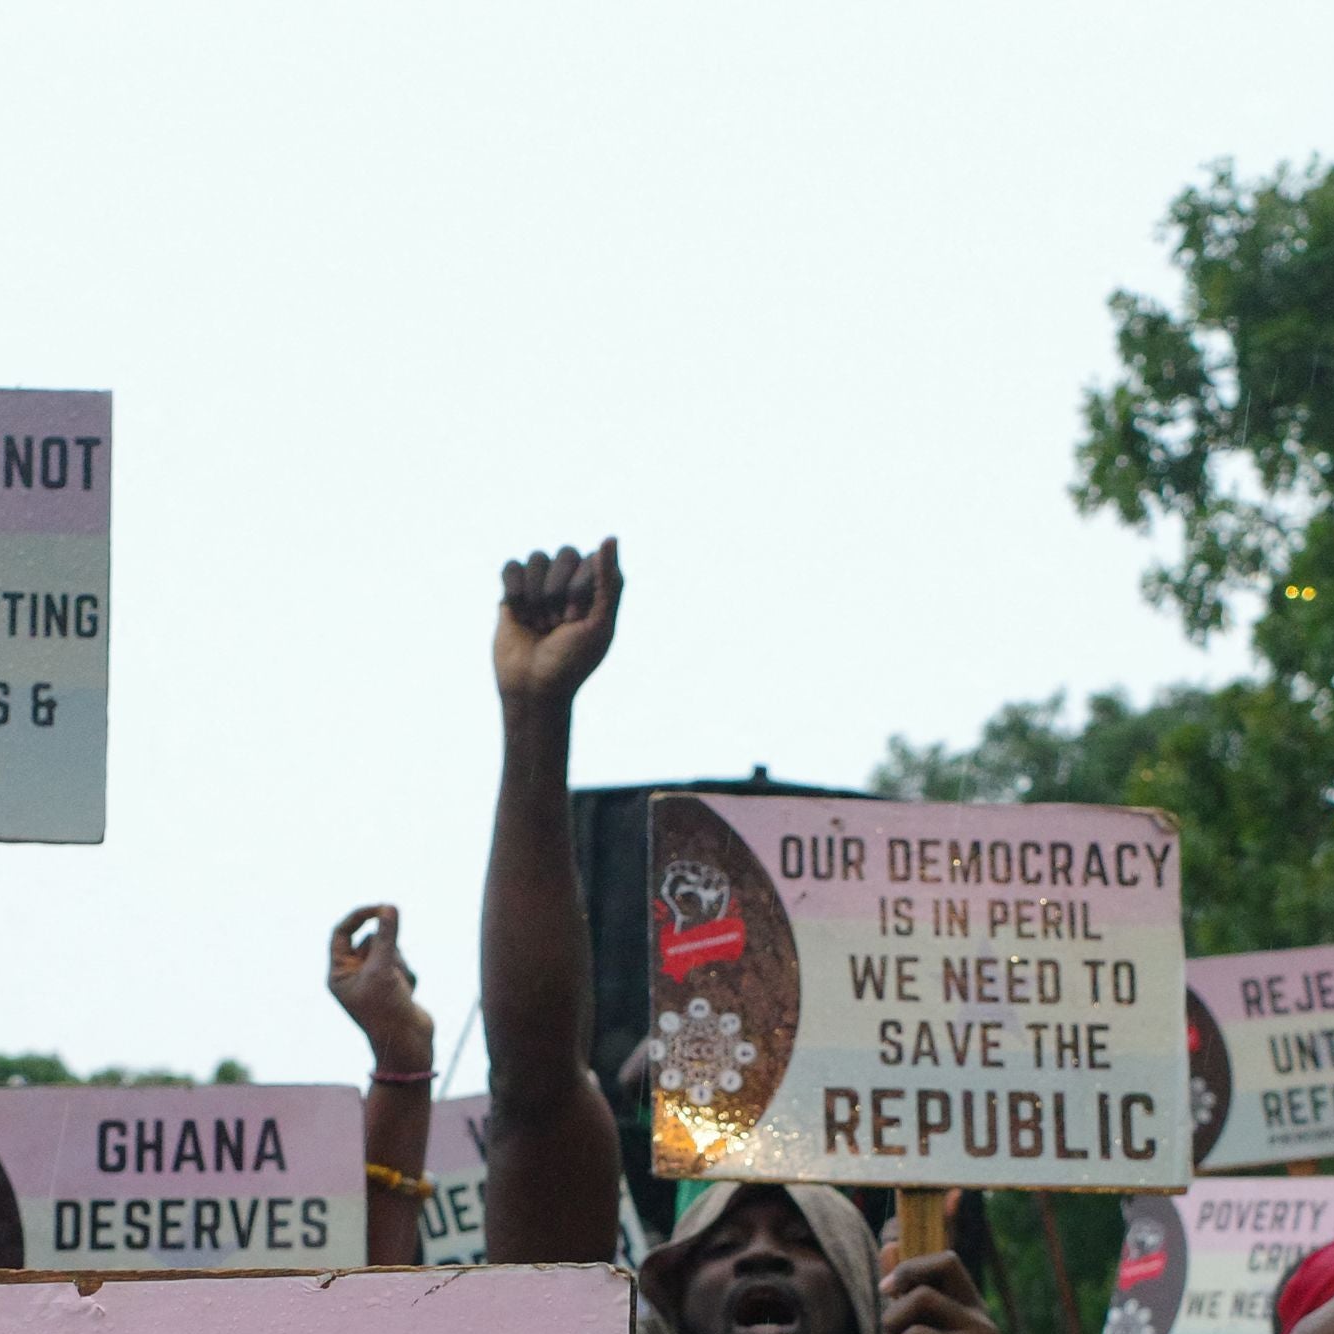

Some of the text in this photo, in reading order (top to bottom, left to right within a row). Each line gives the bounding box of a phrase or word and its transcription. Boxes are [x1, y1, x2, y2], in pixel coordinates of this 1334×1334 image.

[4, 436, 101, 490] NOT
[31, 683, 57, 727] &
[781, 835, 1173, 888] OUR DEMOCRACY
[878, 897, 1103, 941] IS IN PERIL
[850, 954, 1137, 1005] WE NEED TO
[878, 1020, 1112, 1070] SAVE THE
[98, 1117, 286, 1173] GHANA
[823, 1086, 1157, 1161] REPUBLIC
[56, 1200, 328, 1251] DESERVES
[1196, 1200, 1328, 1232] POVERTY
